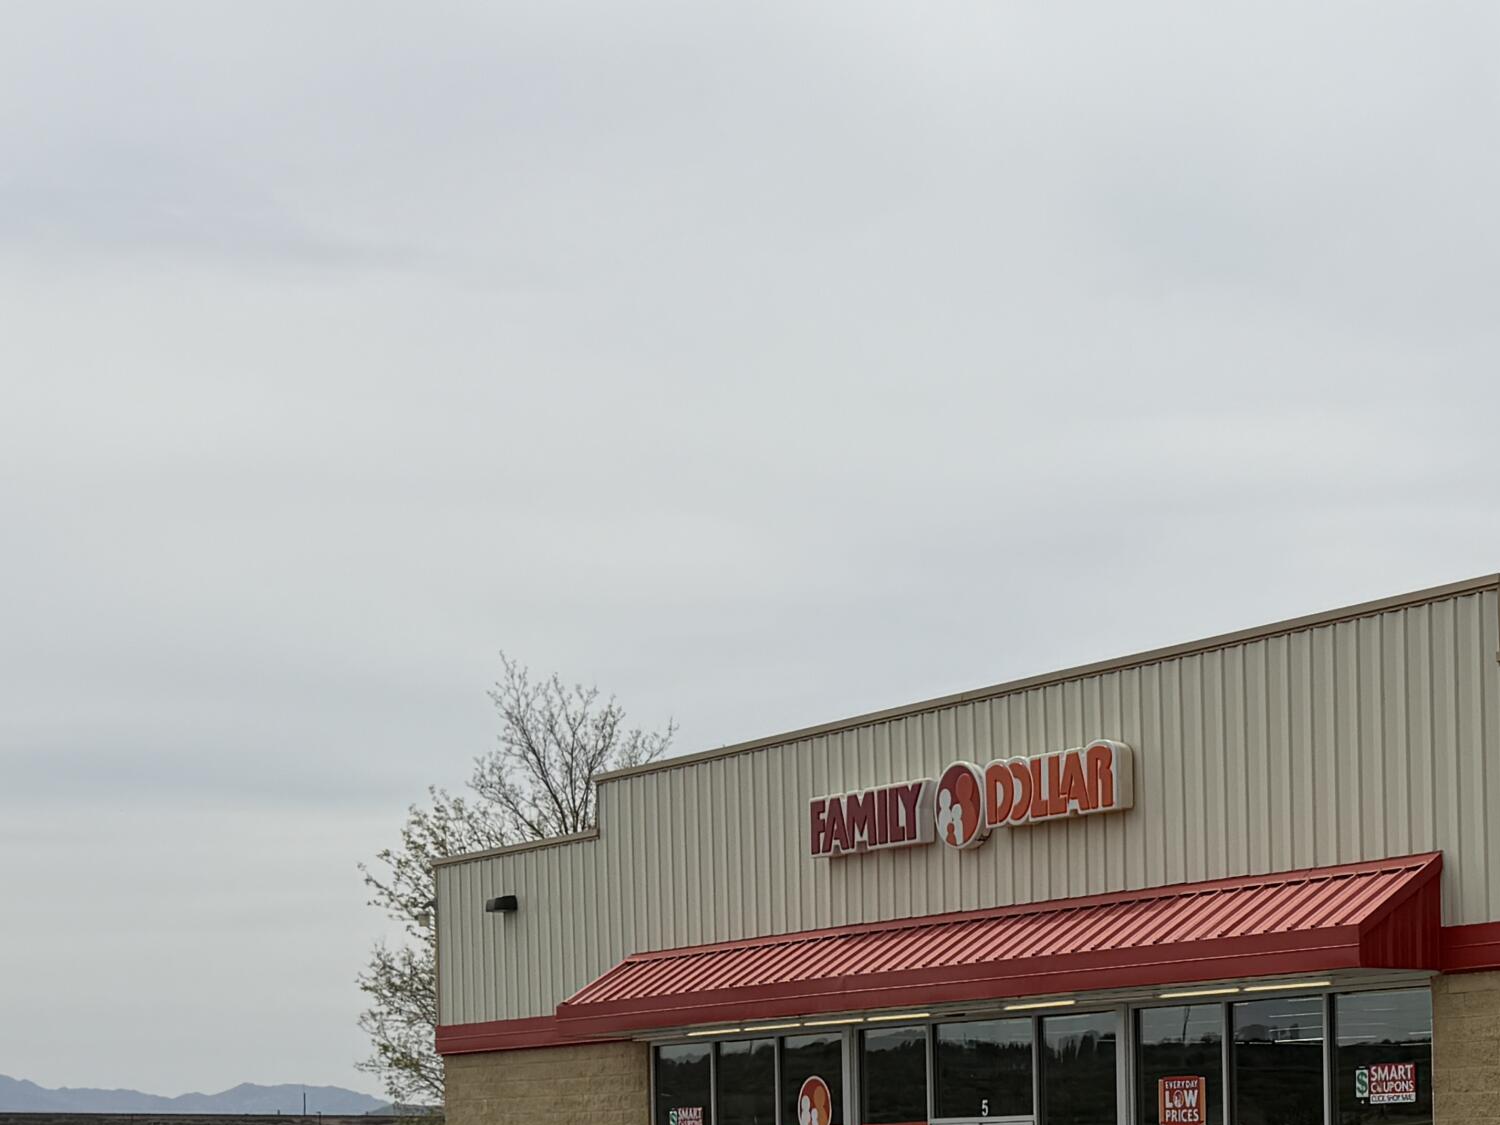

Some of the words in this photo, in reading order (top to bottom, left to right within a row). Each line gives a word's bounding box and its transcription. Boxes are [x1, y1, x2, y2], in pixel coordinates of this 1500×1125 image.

[810, 782, 923, 856] FAMILY
[985, 744, 1114, 827] DOLLAR
[1371, 1064, 1414, 1081] SMART
[1165, 1090, 1198, 1108] LOW
[678, 1107, 703, 1120] SMART
[981, 1099, 989, 1117] 5
[1165, 1109, 1199, 1122] PRICES
